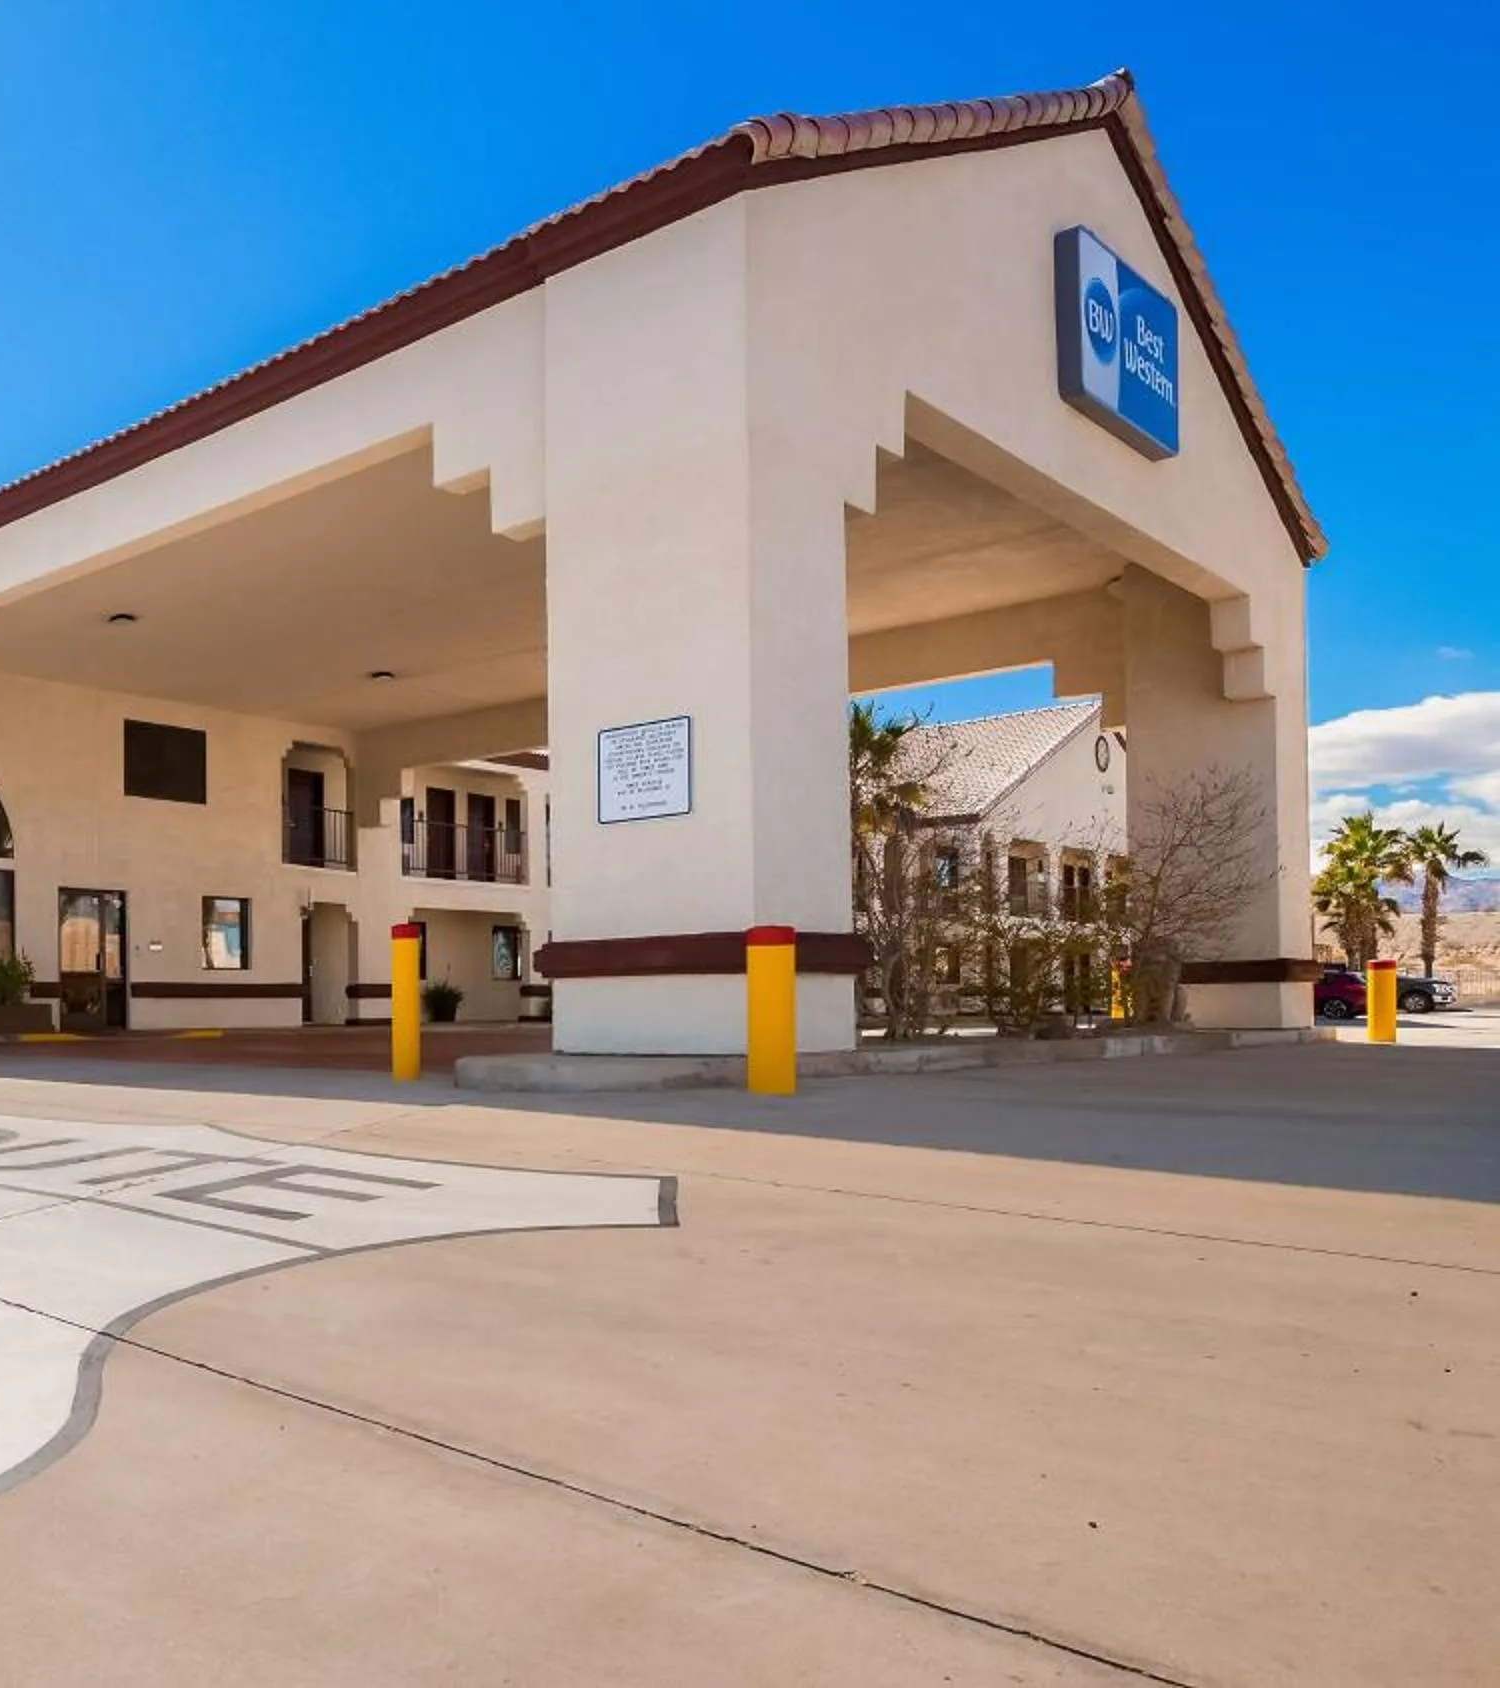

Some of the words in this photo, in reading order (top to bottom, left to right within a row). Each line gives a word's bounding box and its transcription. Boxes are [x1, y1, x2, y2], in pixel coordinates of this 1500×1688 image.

[1088, 298, 1113, 343] BW
[1136, 314, 1164, 363] Best
[1124, 336, 1173, 404] Western
